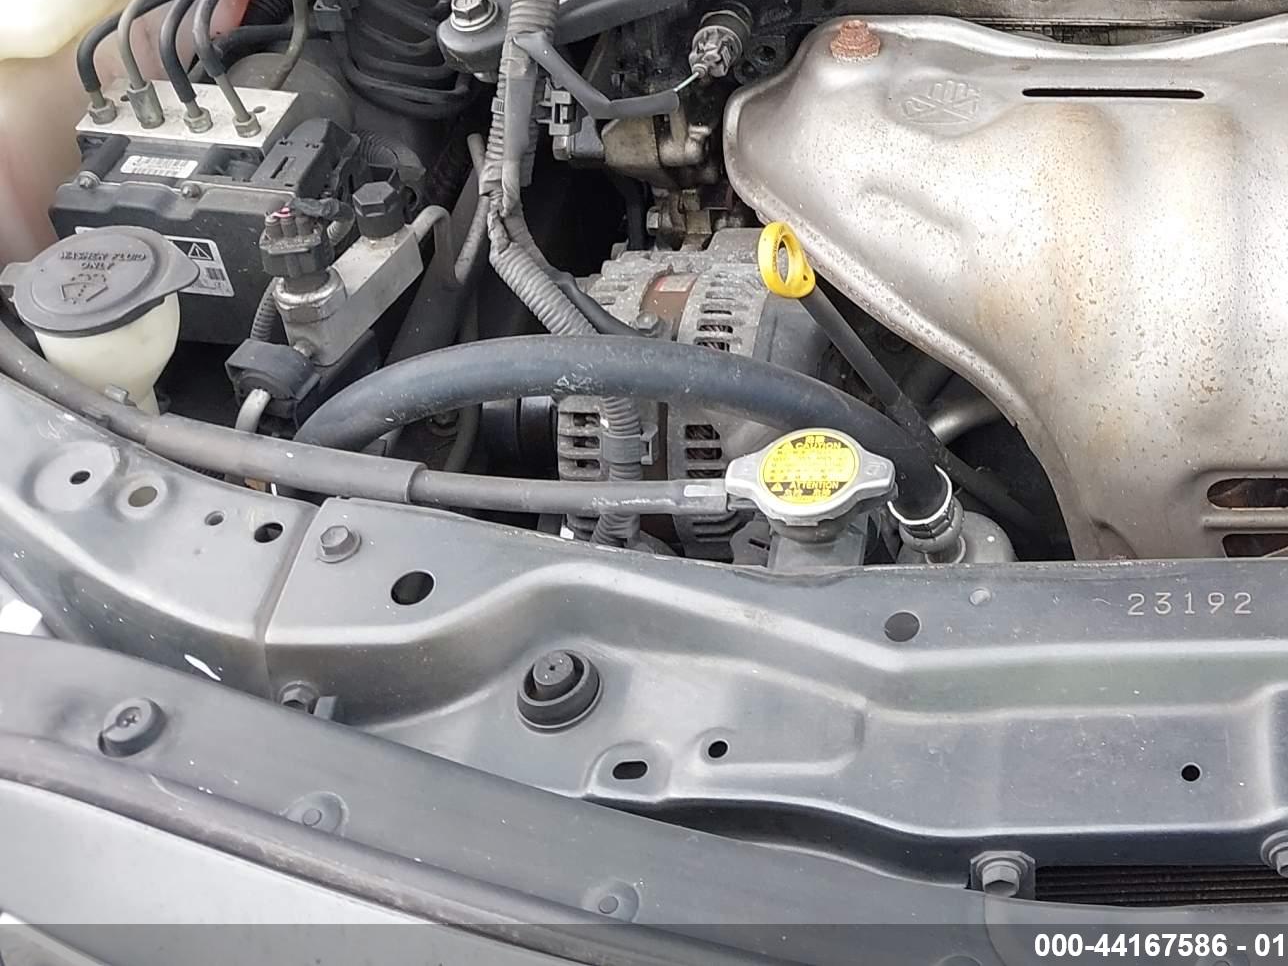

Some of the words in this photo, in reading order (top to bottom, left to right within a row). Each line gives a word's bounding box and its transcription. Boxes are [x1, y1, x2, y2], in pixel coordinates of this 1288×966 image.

[795, 441, 842, 449] CAUTION
[789, 481, 840, 490] ATTENTION
[1127, 591, 1252, 616] 23192
